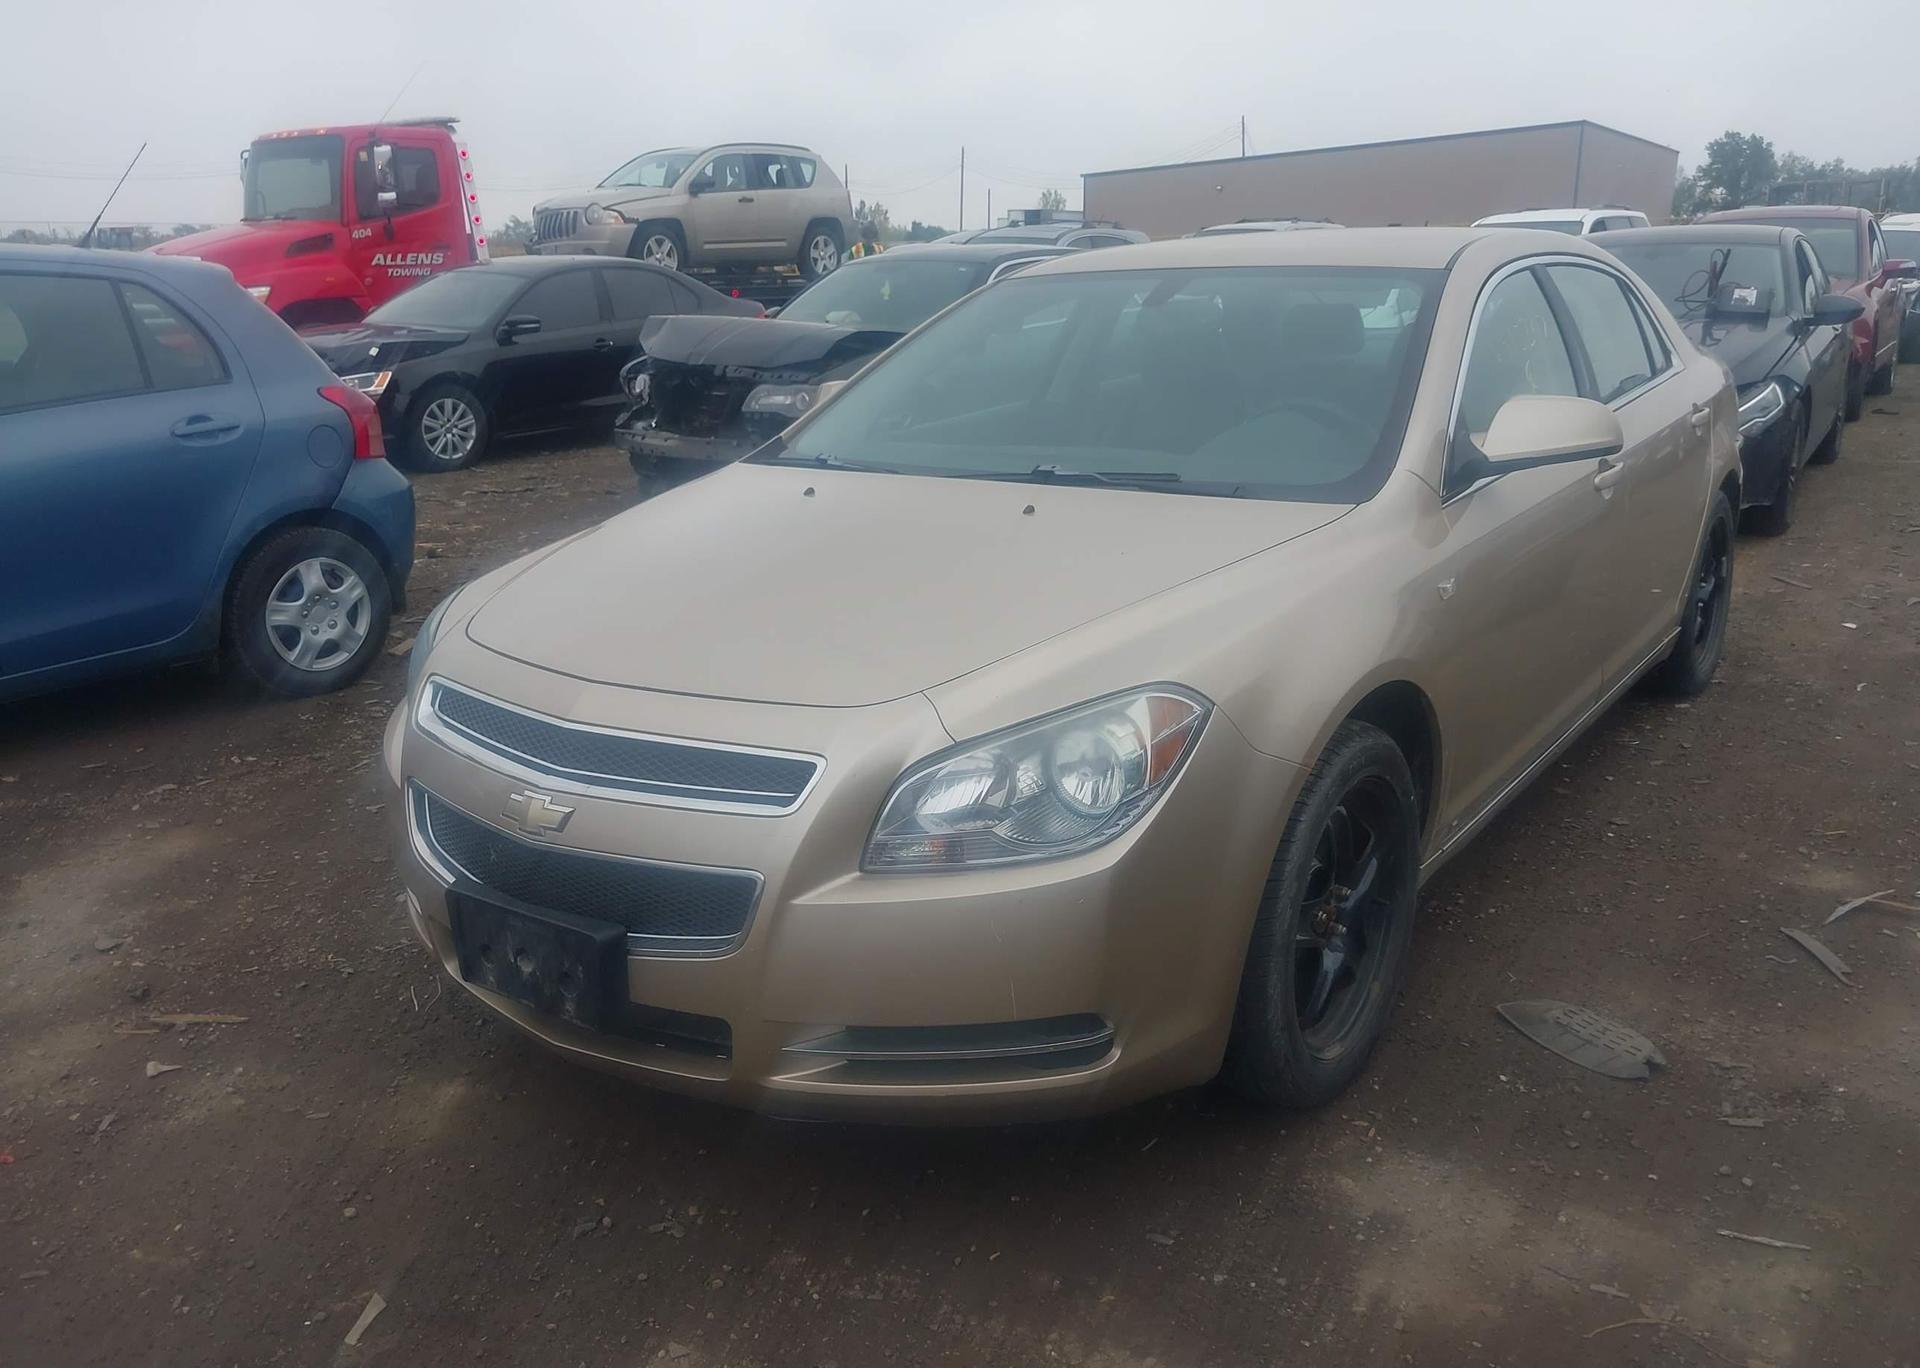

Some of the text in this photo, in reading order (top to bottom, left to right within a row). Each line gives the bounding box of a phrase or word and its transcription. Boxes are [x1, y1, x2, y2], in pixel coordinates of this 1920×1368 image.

[352, 228, 372, 239] 404
[371, 253, 444, 266] ALLENS
[387, 268, 431, 277] TOWING
